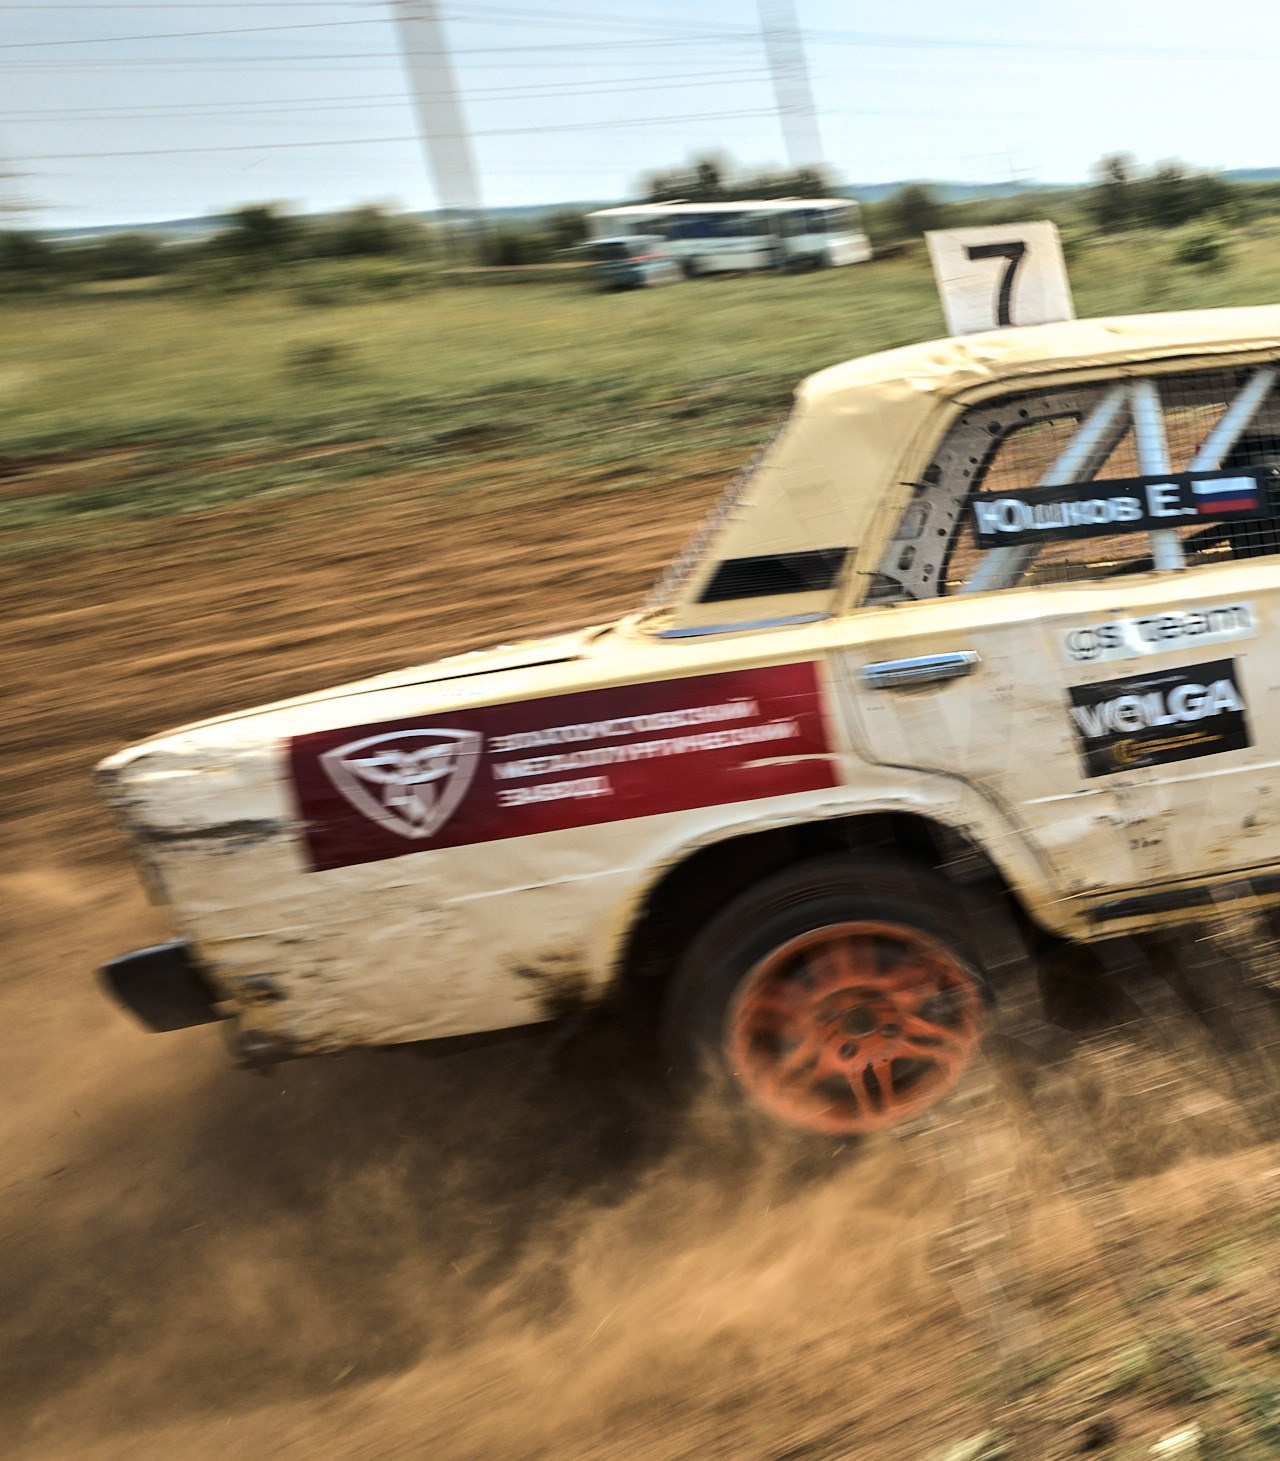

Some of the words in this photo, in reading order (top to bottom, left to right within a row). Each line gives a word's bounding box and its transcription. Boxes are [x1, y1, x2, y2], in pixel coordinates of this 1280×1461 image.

[966, 241, 1026, 326] 7
[973, 497, 1143, 534] Юшков
[1132, 605, 1252, 643] team
[1068, 678, 1247, 738] VOLGA
